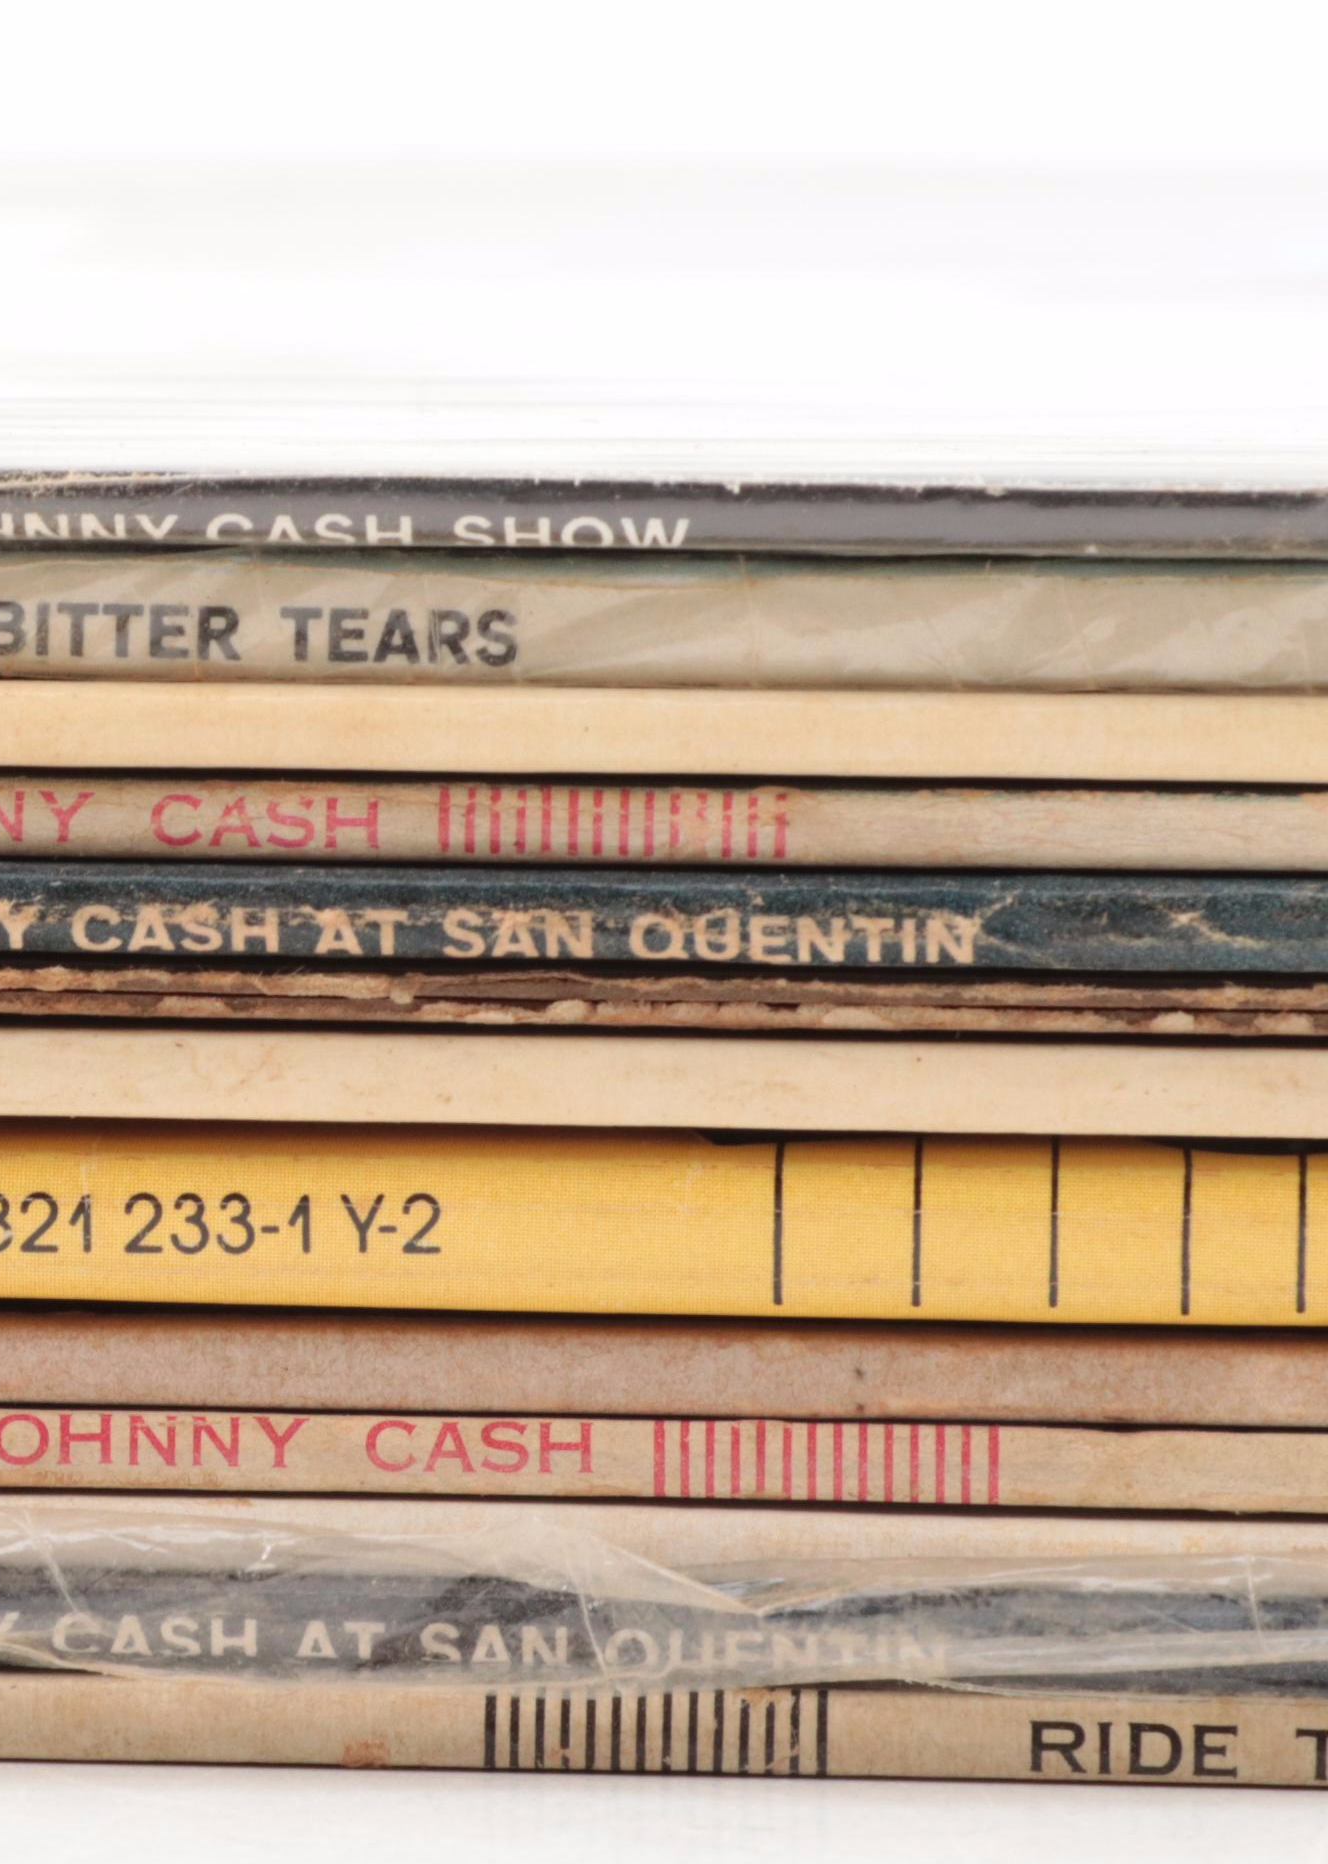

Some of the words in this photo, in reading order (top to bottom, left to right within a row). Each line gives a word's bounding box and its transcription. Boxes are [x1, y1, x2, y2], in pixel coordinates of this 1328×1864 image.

[280, 606, 520, 668] TEARS
[149, 792, 381, 850] CASH
[72, 904, 282, 955] CASH
[313, 908, 409, 957] AT
[442, 908, 596, 960] SAN
[628, 911, 976, 965] QUENTIN
[123, 1190, 313, 1256] 233-1
[339, 1191, 443, 1255] Y-2
[364, 1418, 595, 1475] CASH
[51, 1611, 259, 1658] CASH
[295, 1619, 386, 1660] AT
[419, 1622, 569, 1667] SAN
[1029, 1720, 1239, 1779] RIDE
